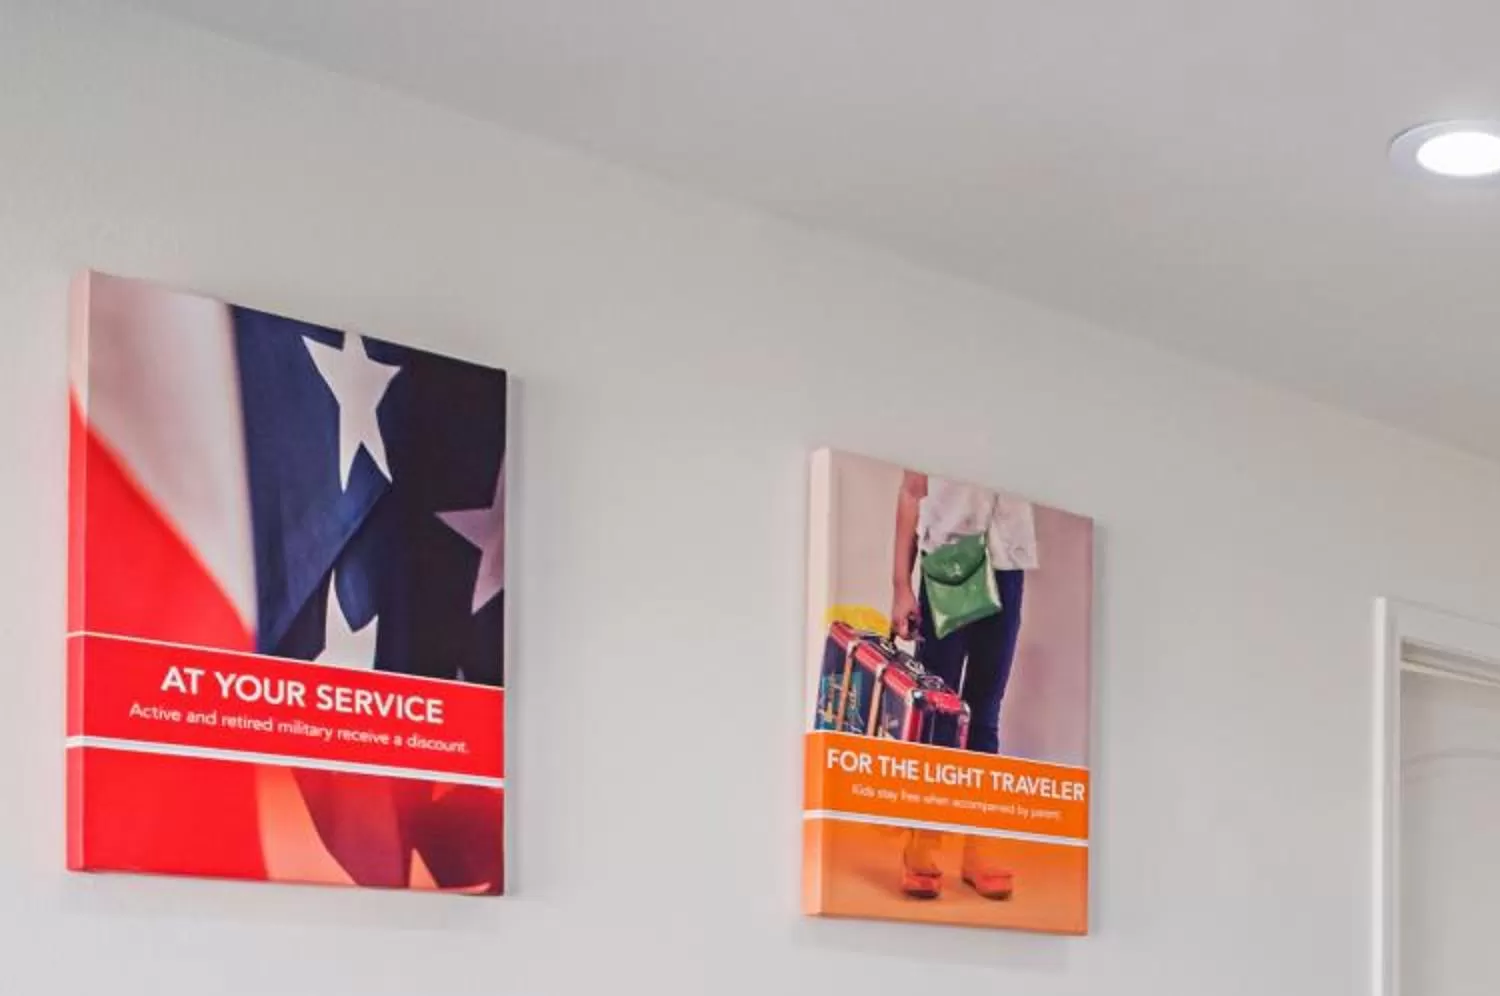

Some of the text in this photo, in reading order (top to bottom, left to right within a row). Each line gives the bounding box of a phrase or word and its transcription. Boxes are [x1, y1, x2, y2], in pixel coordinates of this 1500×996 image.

[160, 665, 444, 724] AT YOUR SERVICE
[129, 702, 470, 753] Active and retired military receive a discount.
[827, 748, 1085, 801] FOR THE LIGHT TRAVELER
